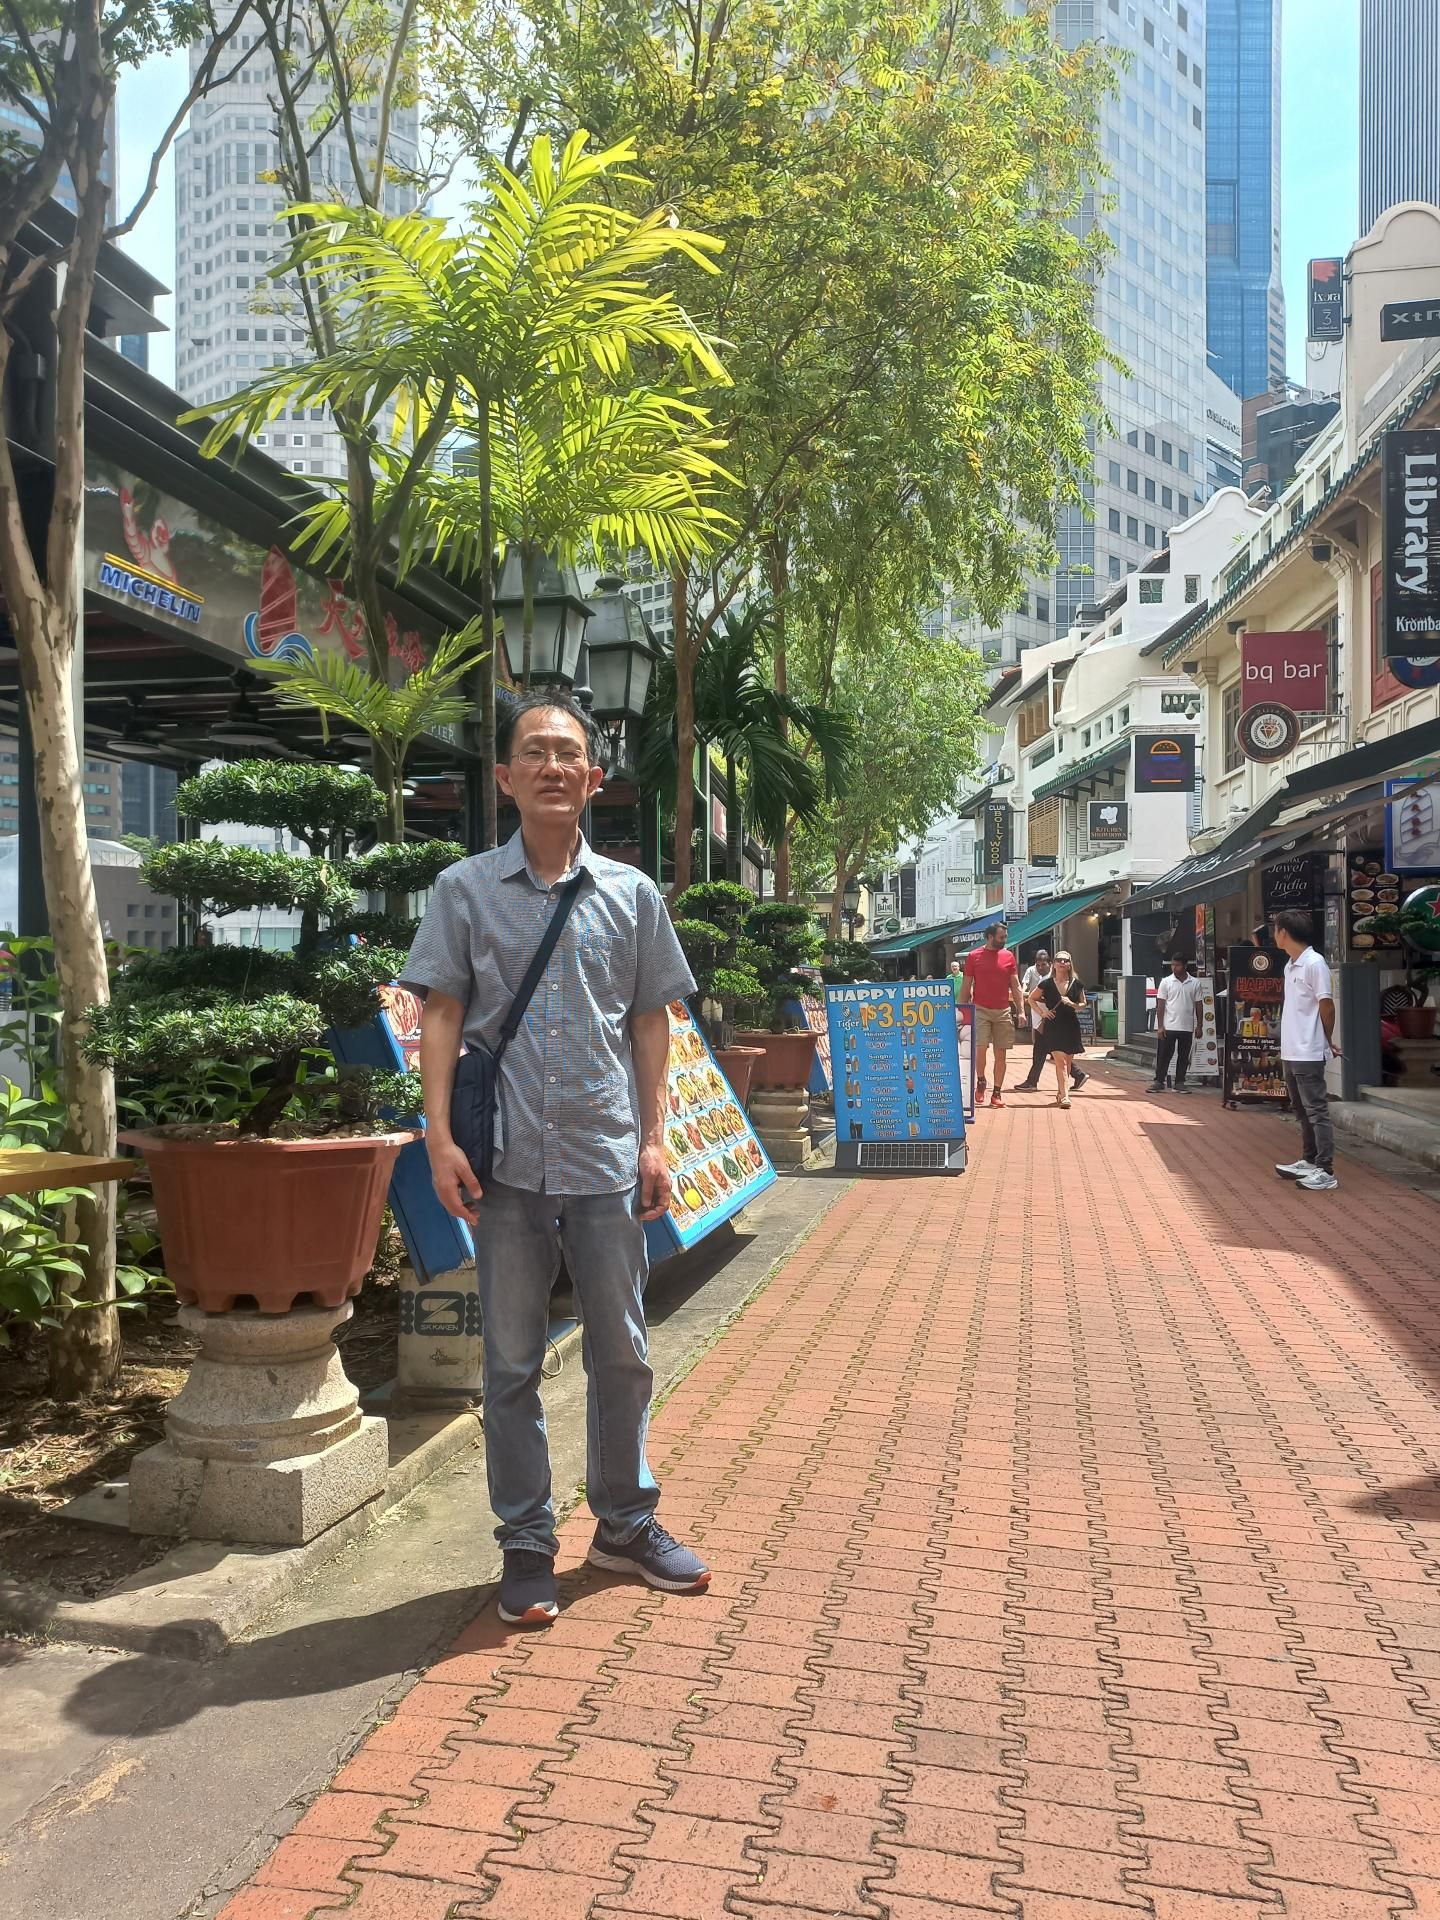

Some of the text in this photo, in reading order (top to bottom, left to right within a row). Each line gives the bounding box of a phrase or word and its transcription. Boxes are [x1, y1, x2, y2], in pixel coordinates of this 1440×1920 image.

[1395, 453, 1438, 595] Library
[100, 562, 201, 624] MICHELIN
[1245, 659, 1323, 684] bq bar
[989, 811, 1004, 865] BOLLYWOOD
[1268, 860, 1309, 873] Jewel
[828, 984, 953, 1003] HAPPY HOUR
[836, 1020, 860, 1031] Tiger
